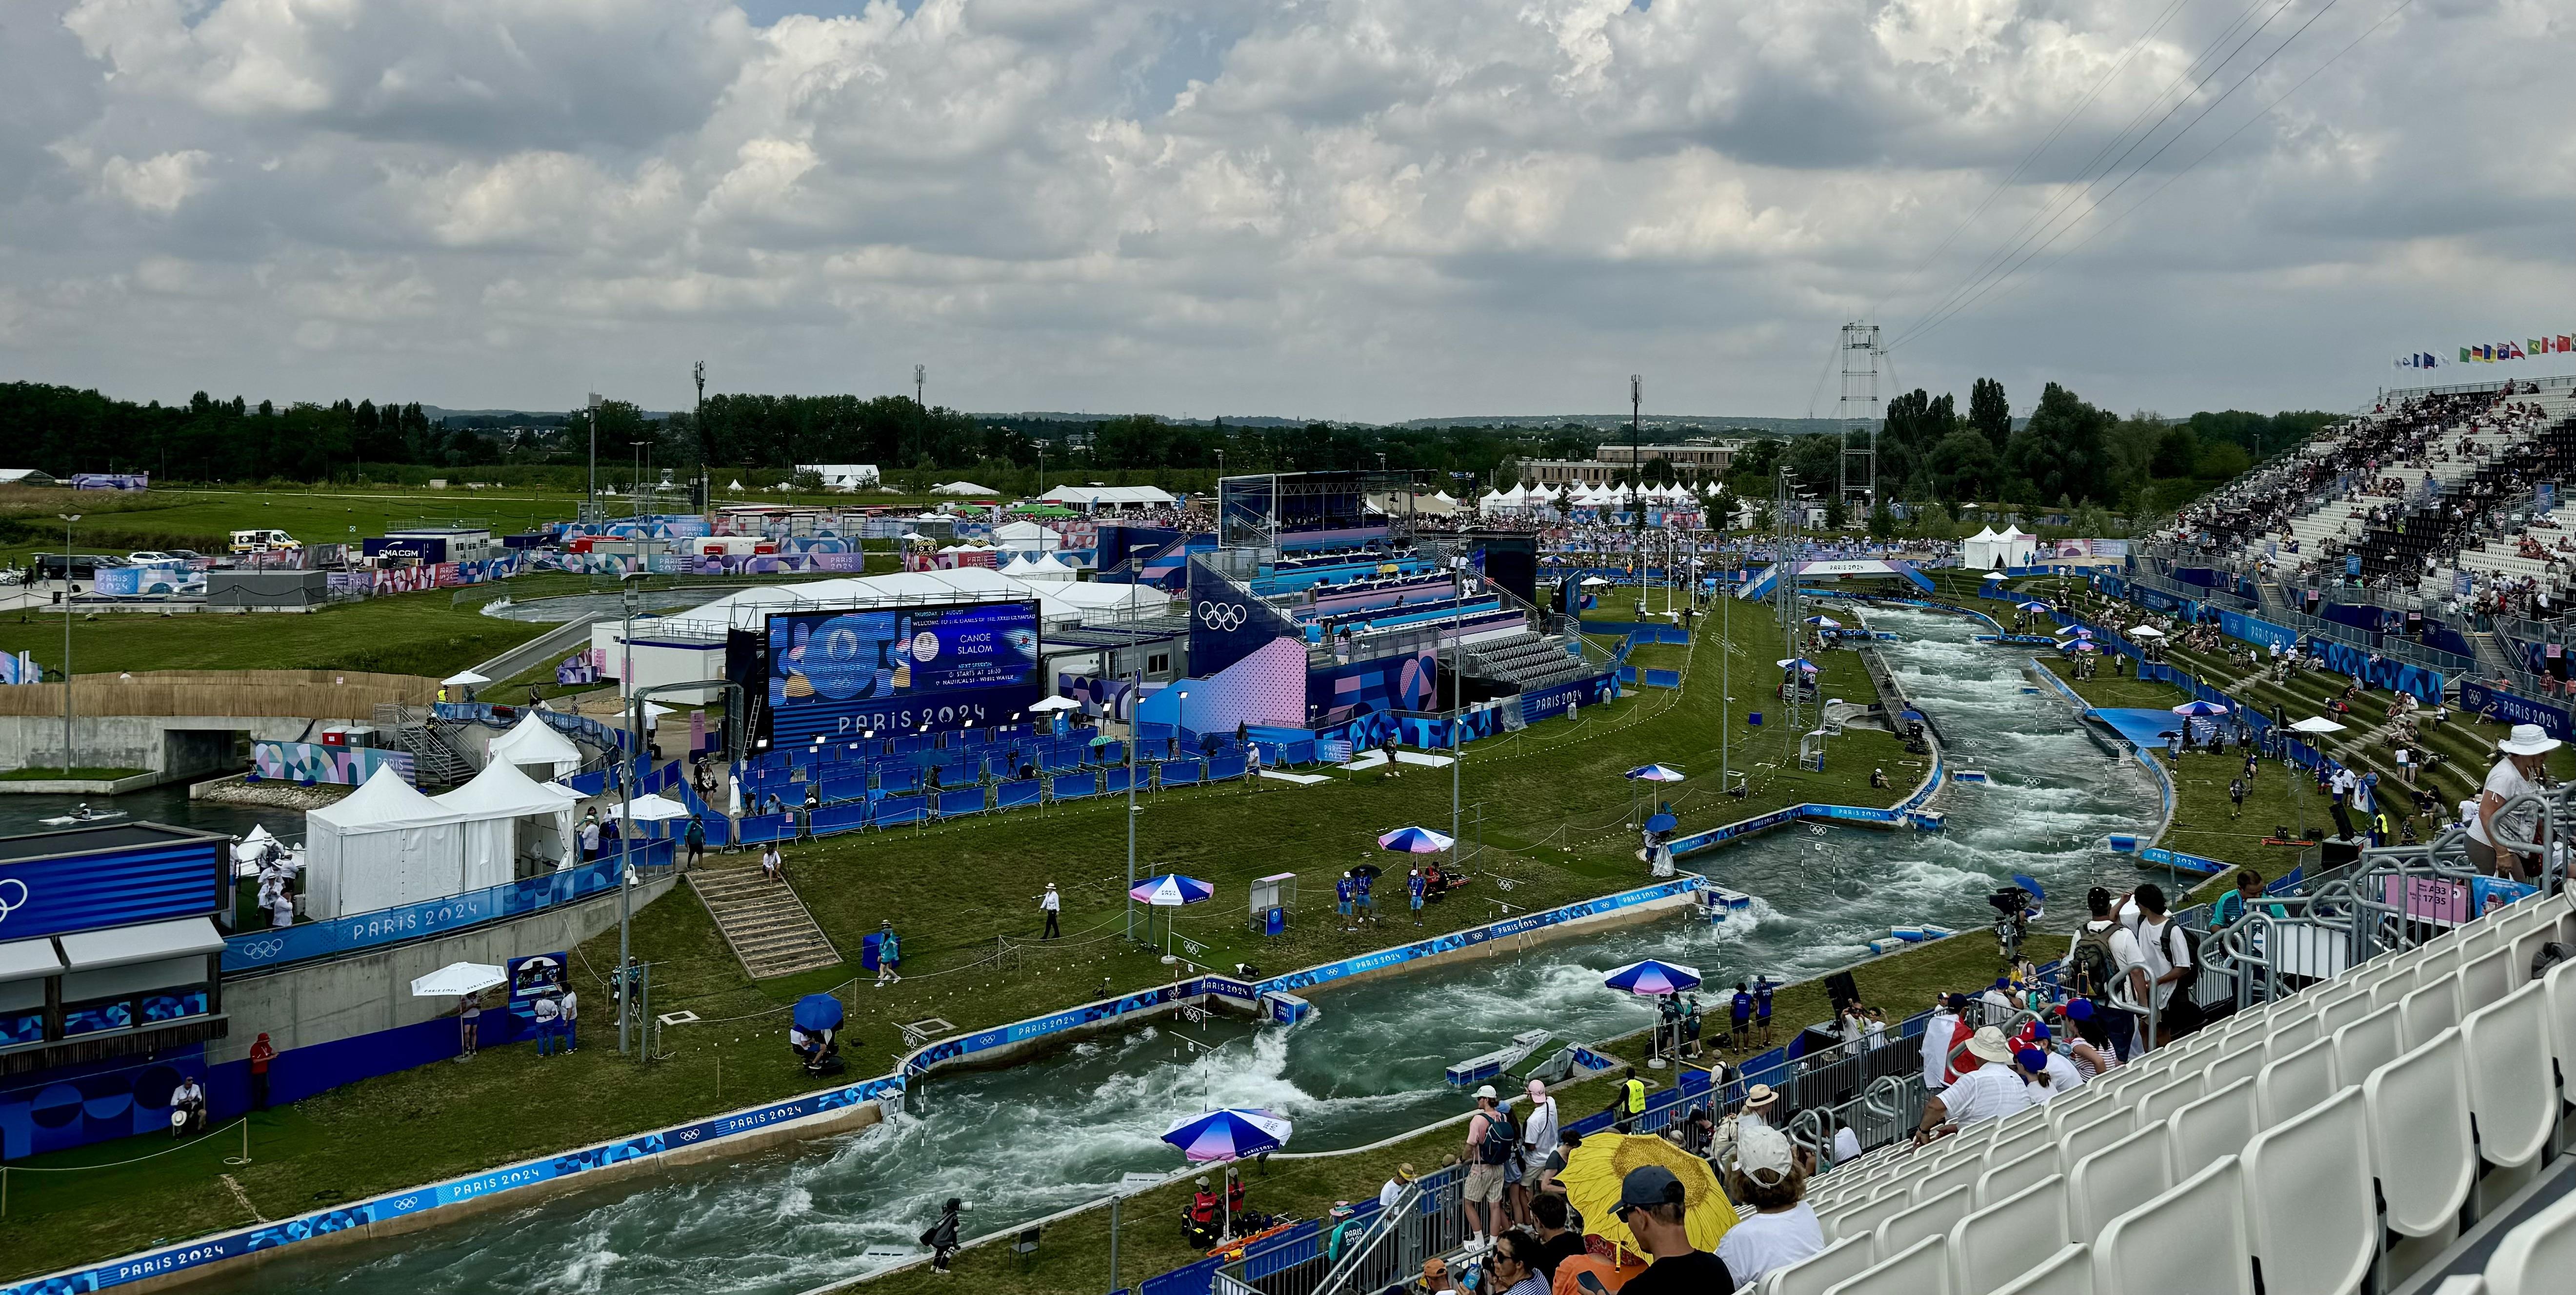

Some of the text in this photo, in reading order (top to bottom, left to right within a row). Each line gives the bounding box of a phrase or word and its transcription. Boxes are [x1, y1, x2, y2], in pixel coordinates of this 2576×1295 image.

[2148, 594, 2159, 607] PARIS
[960, 633, 991, 643] CANOE
[2251, 626, 2286, 648] PARIS 2024
[958, 645, 993, 654] SLALOM
[1537, 689, 1581, 711] PARIS 2024
[839, 711, 911, 734] PARIS
[2504, 701, 2557, 729] PARIS 2024
[2177, 857, 2197, 866] 2024
[1622, 890, 1658, 903] PARIS 2024
[354, 902, 477, 940] PARIS 2024
[1498, 919, 1538, 934] PARIS 2024
[1356, 953, 1400, 969] PARIS 2024
[1227, 985, 1247, 995] 2024
[1019, 1016, 1074, 1035] PARIS 2024
[730, 1105, 802, 1130] PARIS 2024
[454, 1170, 539, 1196] PARIS 2024
[1344, 1228, 1362, 1239] PARIS
[120, 1246, 223, 1278] PARIS 2024
